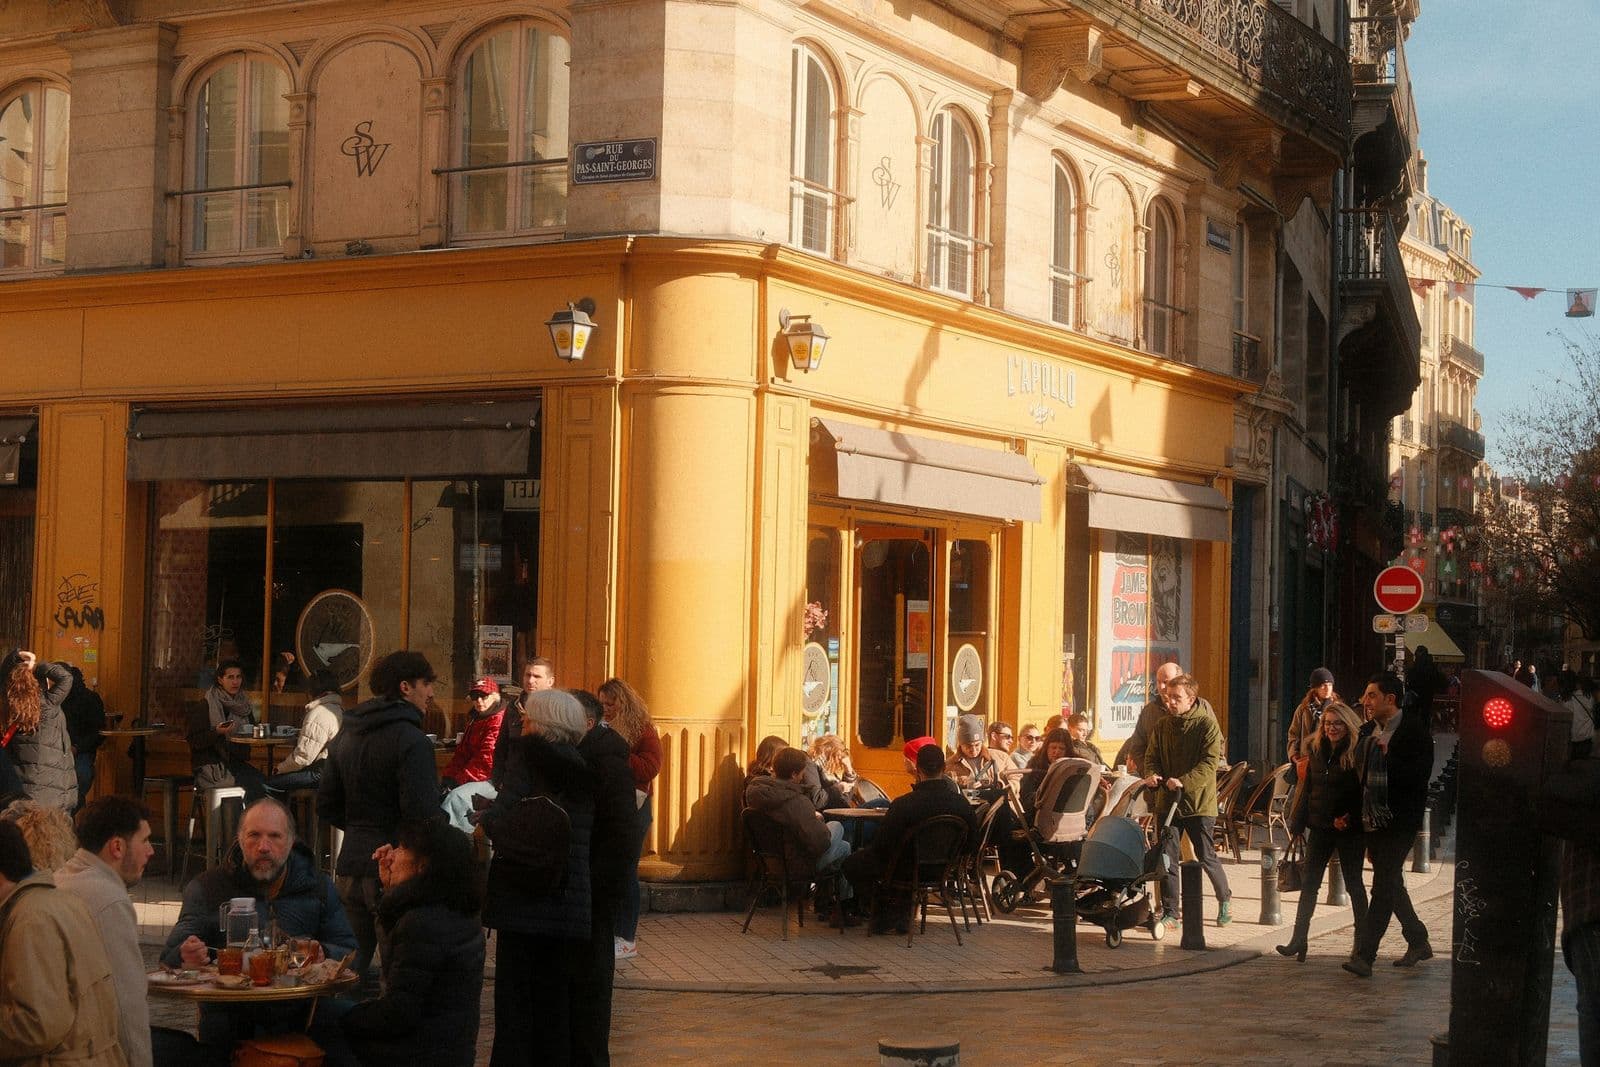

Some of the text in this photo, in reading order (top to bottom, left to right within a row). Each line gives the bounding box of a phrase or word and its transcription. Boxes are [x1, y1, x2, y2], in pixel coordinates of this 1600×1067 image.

[606, 144, 623, 154] RUE
[576, 159, 652, 173] PAS-SAINT-GEORGES
[1007, 354, 1075, 408] L'APOLLO
[1119, 571, 1147, 595] JAME
[1112, 596, 1148, 627] BROW
[1111, 705, 1135, 722] THUR.
